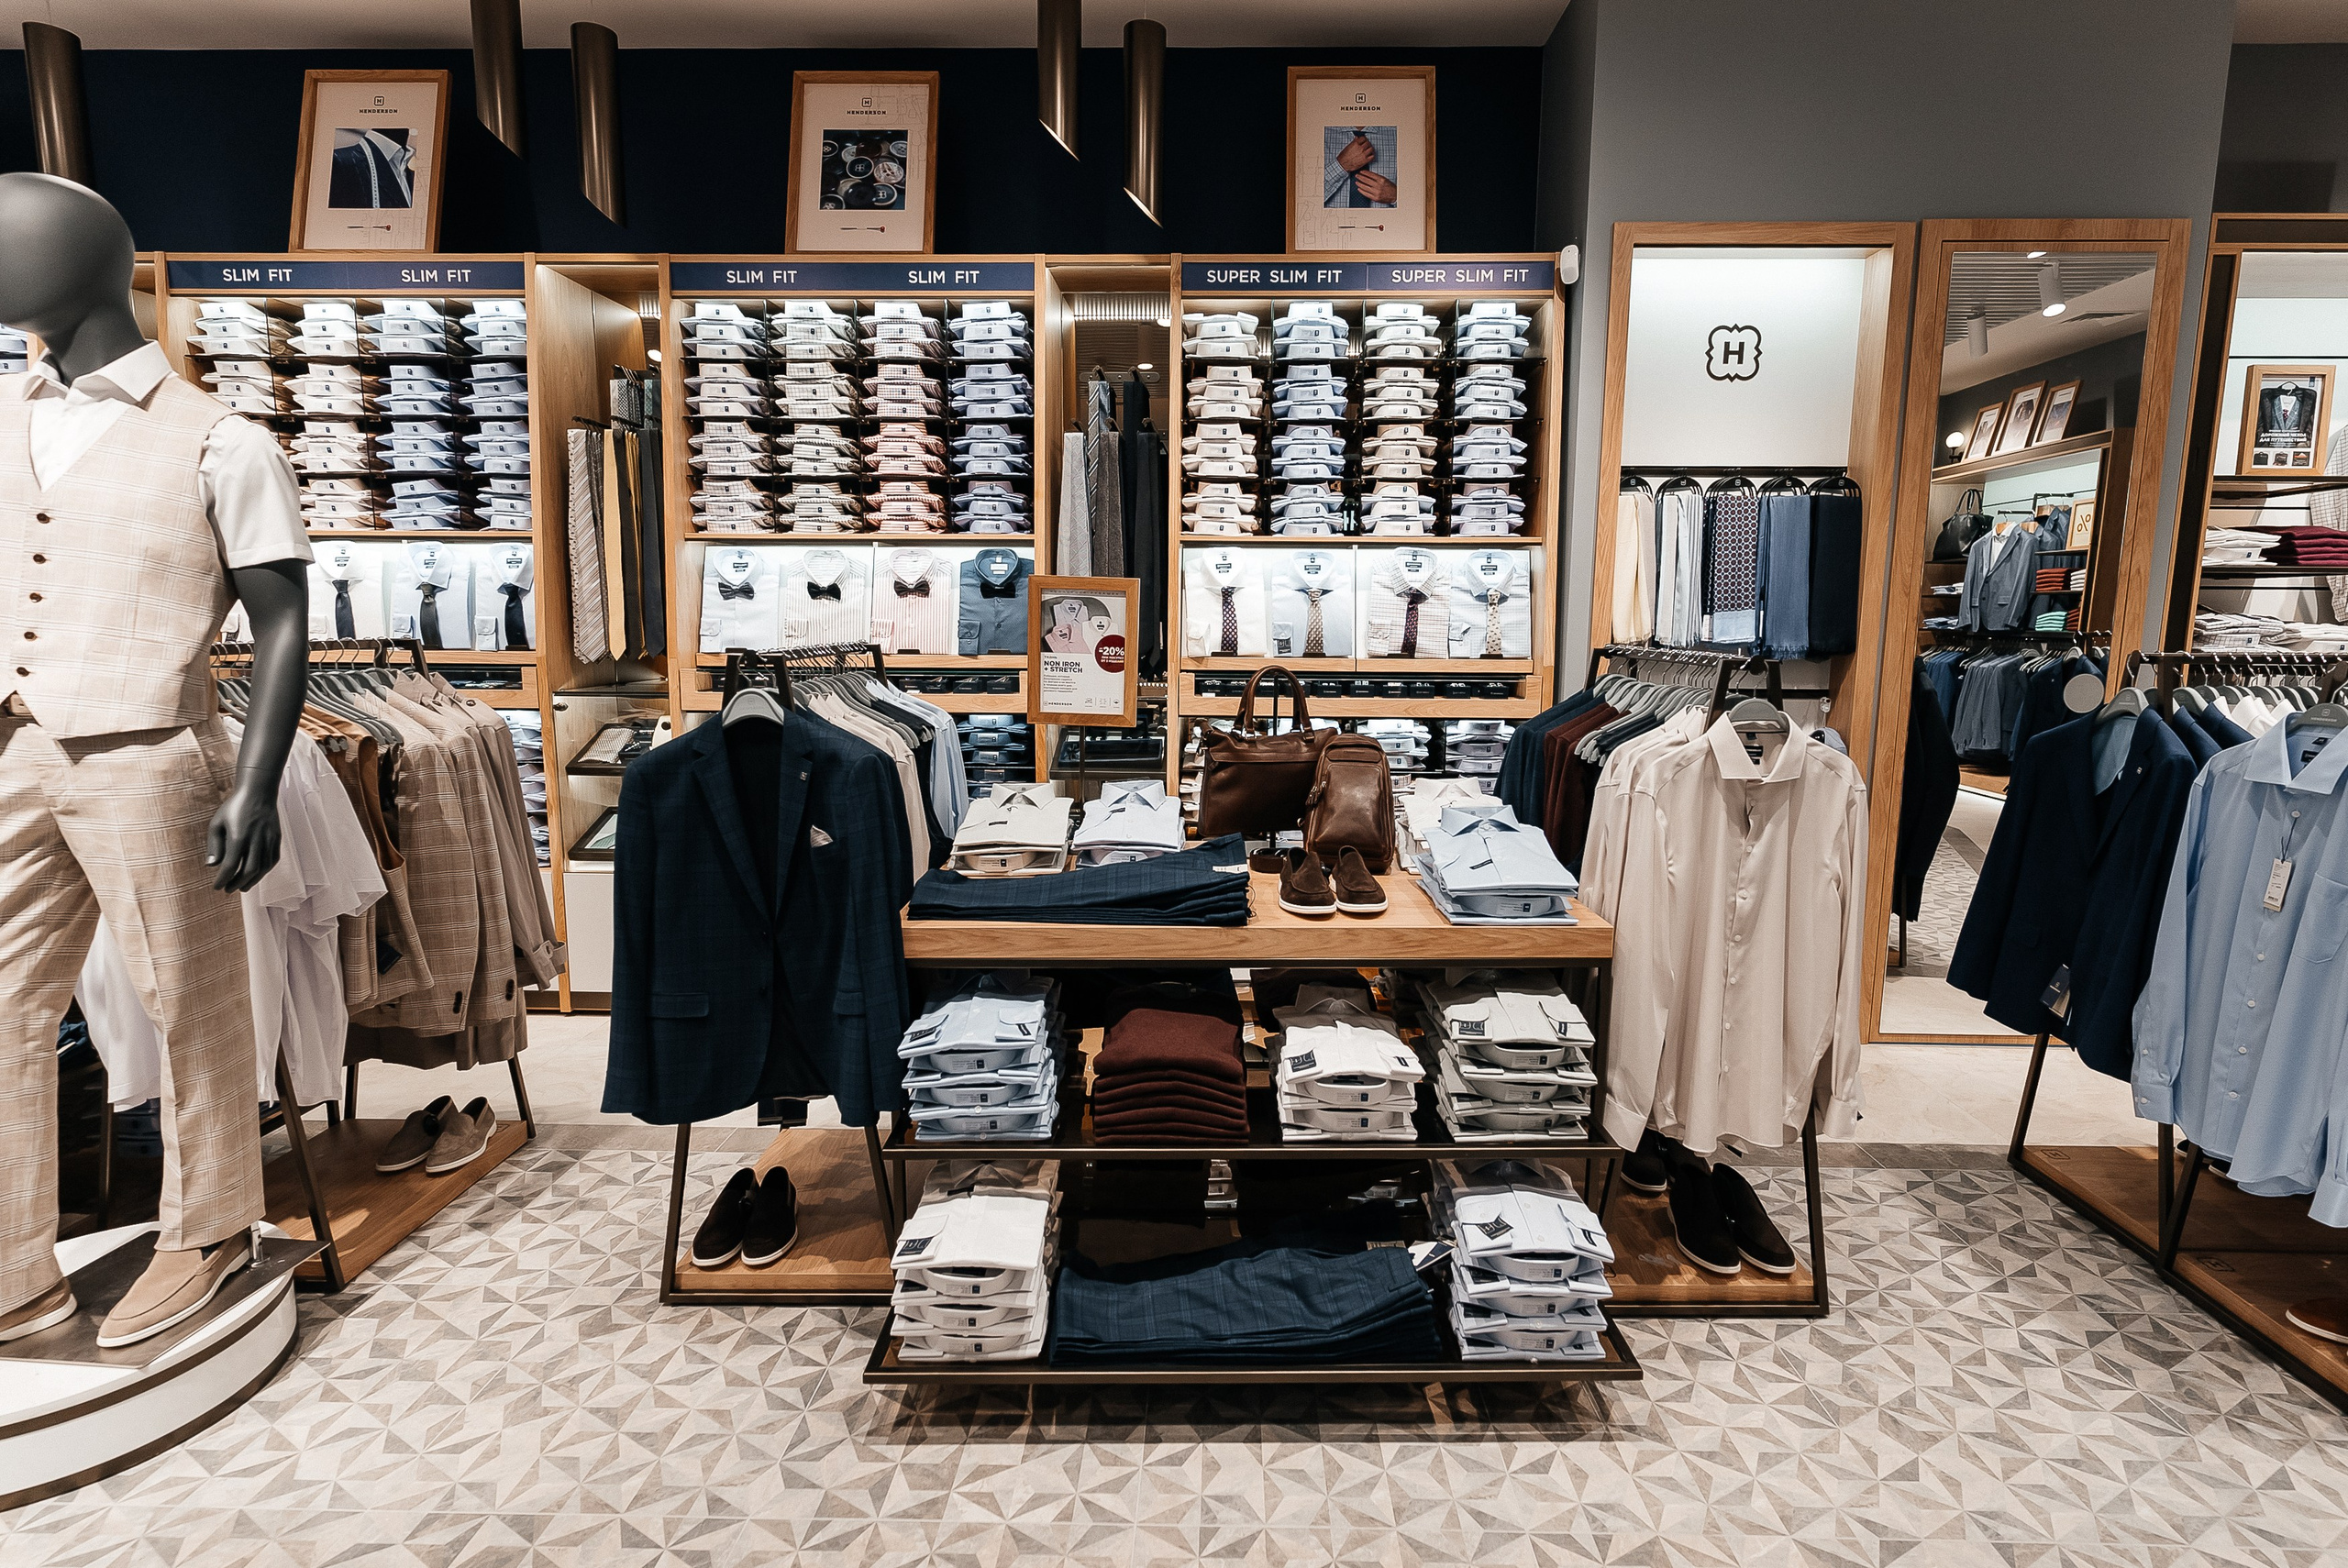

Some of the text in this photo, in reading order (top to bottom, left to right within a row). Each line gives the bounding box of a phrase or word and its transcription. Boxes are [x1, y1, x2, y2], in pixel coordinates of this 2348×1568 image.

[222, 269, 293, 282] SLIM FIT
[401, 269, 471, 282] SLIM FIT
[726, 271, 797, 283] SLIM FIT
[908, 271, 980, 284] SLIM FIT
[1206, 270, 1343, 283] SUPER SLIM FIT
[1391, 269, 1529, 283] SUPER SLIM FIT
[1722, 341, 1745, 365] H
